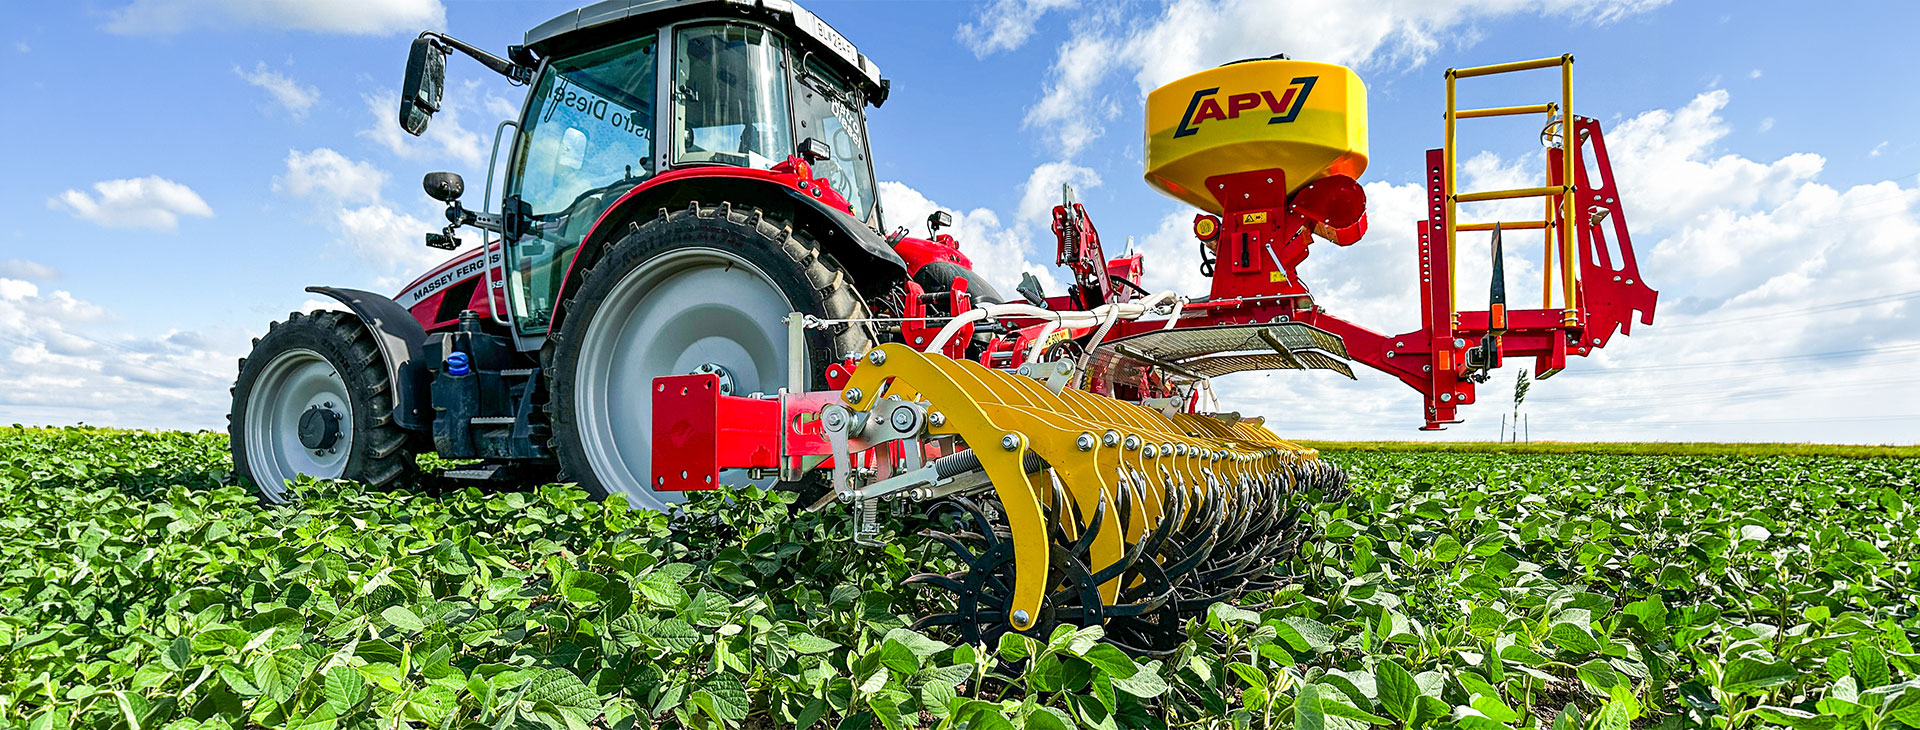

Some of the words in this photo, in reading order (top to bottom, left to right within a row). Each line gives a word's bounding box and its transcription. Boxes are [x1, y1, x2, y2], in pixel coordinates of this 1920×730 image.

[1192, 87, 1298, 125] APV
[413, 272, 453, 301] MASSEY
[456, 253, 502, 278] FERGS
